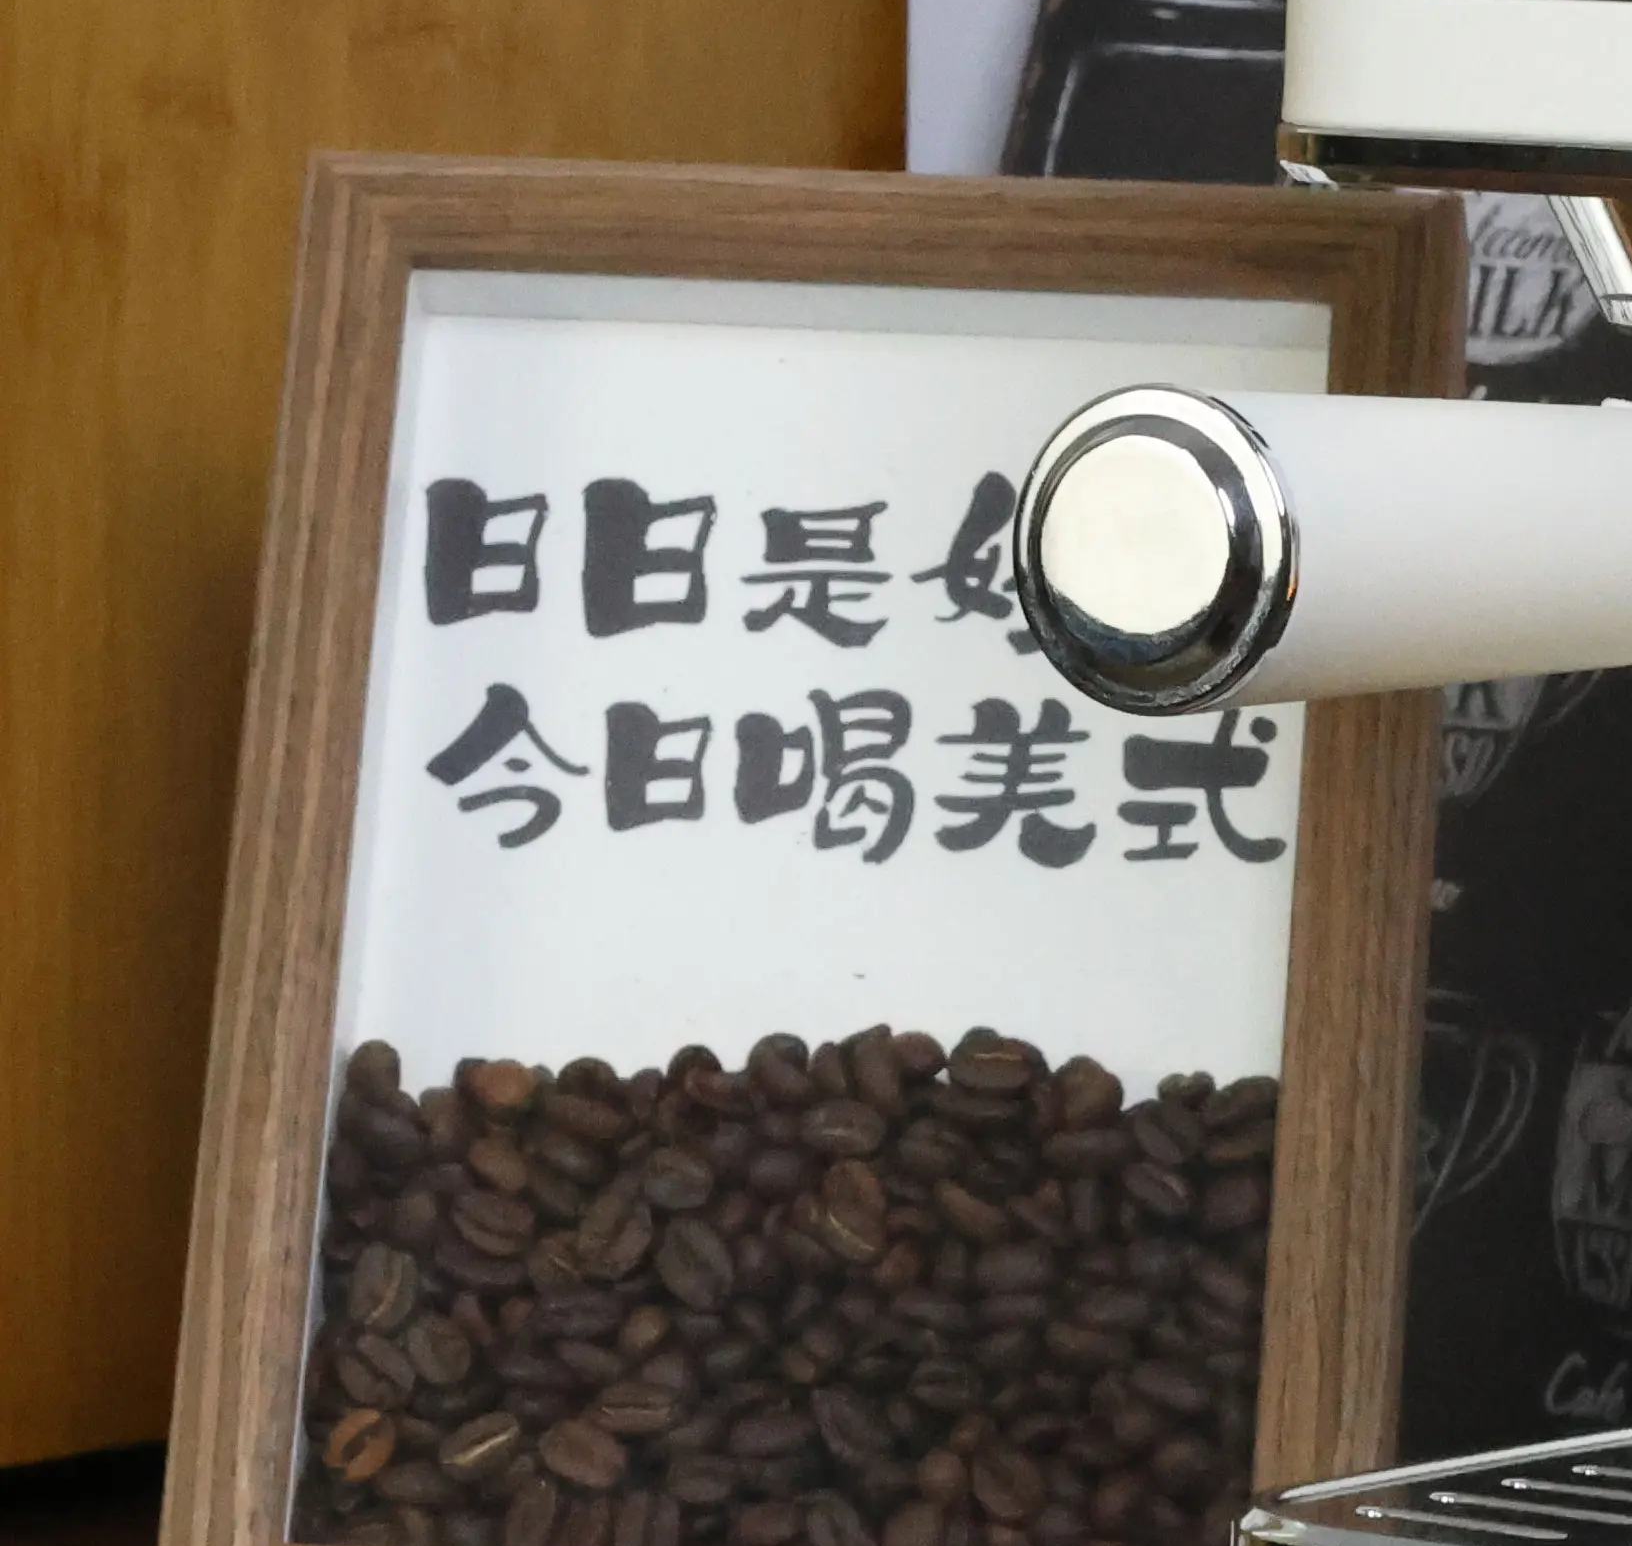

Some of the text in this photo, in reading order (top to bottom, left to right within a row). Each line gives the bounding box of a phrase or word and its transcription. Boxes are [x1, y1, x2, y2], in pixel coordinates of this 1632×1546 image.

[1470, 264, 1587, 338] ILK
[426, 682, 1288, 868] 今日喝美式
